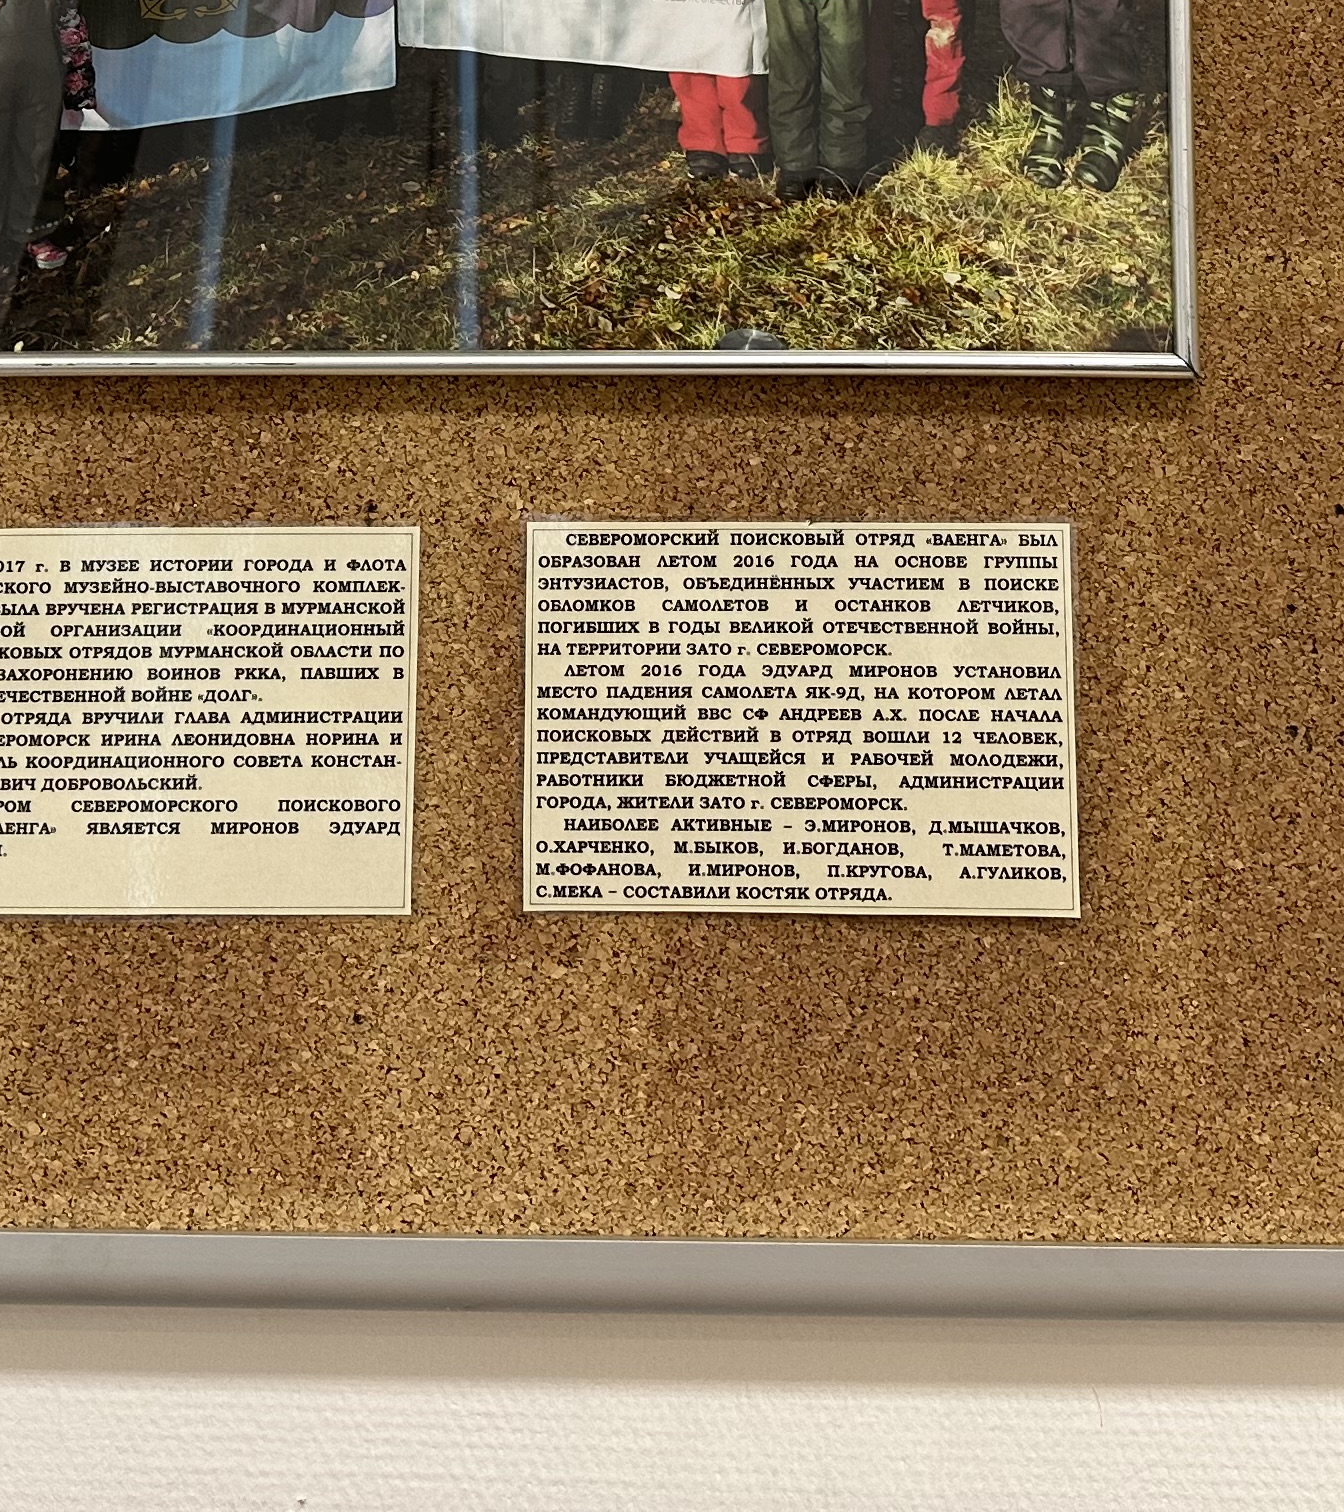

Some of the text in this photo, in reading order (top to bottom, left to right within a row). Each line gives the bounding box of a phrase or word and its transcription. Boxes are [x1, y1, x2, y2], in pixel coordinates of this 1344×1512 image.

[564, 530, 1059, 549] СЕВЕРОМОРСКИЙ ПОИСКОВЫЙ ОТРЯД «ВАЕНГА» БЫЛ
[34, 562, 49, 573] г.
[58, 559, 72, 573] В
[79, 558, 140, 573] МУЗЕЕ
[148, 558, 234, 572] ИСТОРИИ
[242, 558, 315, 574] ГОРОДА
[322, 558, 337, 572] И
[345, 557, 408, 572] ФЛОТА
[62, 577, 301, 594] МУЗЕЙНО-ВЫСТАВОЧНОГО
[311, 579, 406, 594] КОМПЛЕК-
[537, 573, 1060, 593] ЭНТУЗИАСТОВ, ОБЪЕДИНЁННЫХ УЧАСТИЕМ В ПОИСКЕ
[537, 598, 1060, 617] ОБЛОМКОВ САМОЛЕТОВ И ОСТАНКОВ ЛЕТЧИКОВ,
[49, 623, 183, 639] ОРГАНИЗАЦИИ
[205, 618, 406, 639] «КООРДИНАЦИОННЫЙ
[129, 685, 193, 703] ВОЙНЕ
[196, 688, 264, 705] «ДОЛГ».
[0, 711, 73, 727] ОТРЯДА
[80, 710, 165, 725] ВРУЧИЛИ
[173, 710, 232, 725] ГЛАВА
[238, 709, 404, 726] АДМИНИСТРАЦИИ
[24, 754, 225, 771] КООРДИНАЦИОННОГО
[232, 754, 304, 769] СОВЕТА
[309, 753, 403, 768] КОНСТАН-
[535, 747, 1064, 771] ПРЕДСТАВИТЕЛИ УЧАЩЕЙСЯ И РАБОЧЕЙ МОЛОДЕЖИ,
[39, 772, 203, 793] ДОБРОВОЛЬСКИЙ.
[535, 769, 1065, 792] РАБОТНИКИ БЮДЖЕТНОЙ СФЕРЫ, АДМИНИСТРАЦИИ
[69, 798, 239, 813] СЕВЕРОМОРСКОГО
[276, 798, 402, 813] ПОИСКОВОГО
[535, 794, 908, 812] ГОРОДА, ЖИТЕЛИ ЗАТО г. СЕВЕРОМОРСК.
[84, 821, 182, 836] ЯВЛЯЕТСЯ
[209, 820, 300, 835] МИРОНОВ
[328, 820, 401, 837] ЭДУАРД
[562, 817, 660, 832] НАИБОЛЕЕ
[669, 817, 773, 833] АКТИВНЫЕ
[803, 818, 917, 837] Э.МИРОНОВ,
[927, 819, 1066, 838] Д.МЫШАЧКОВ,
[535, 839, 1067, 861] О.ХАРЧЕНКО, М.БЫКОВ, И.БОГДАНОВ, Т.МАМЕТОВА,
[535, 861, 1067, 884] М.ФОФАНОВА, И.МИРОНОВ, П.КРУГОВА, А.ГУЛИКОВ,
[534, 884, 604, 899] С.МЕКА
[621, 884, 731, 900] СОСТАВИЛИ
[734, 885, 811, 901] КОСТЯК
[814, 886, 893, 903] ОТРЯДА.
